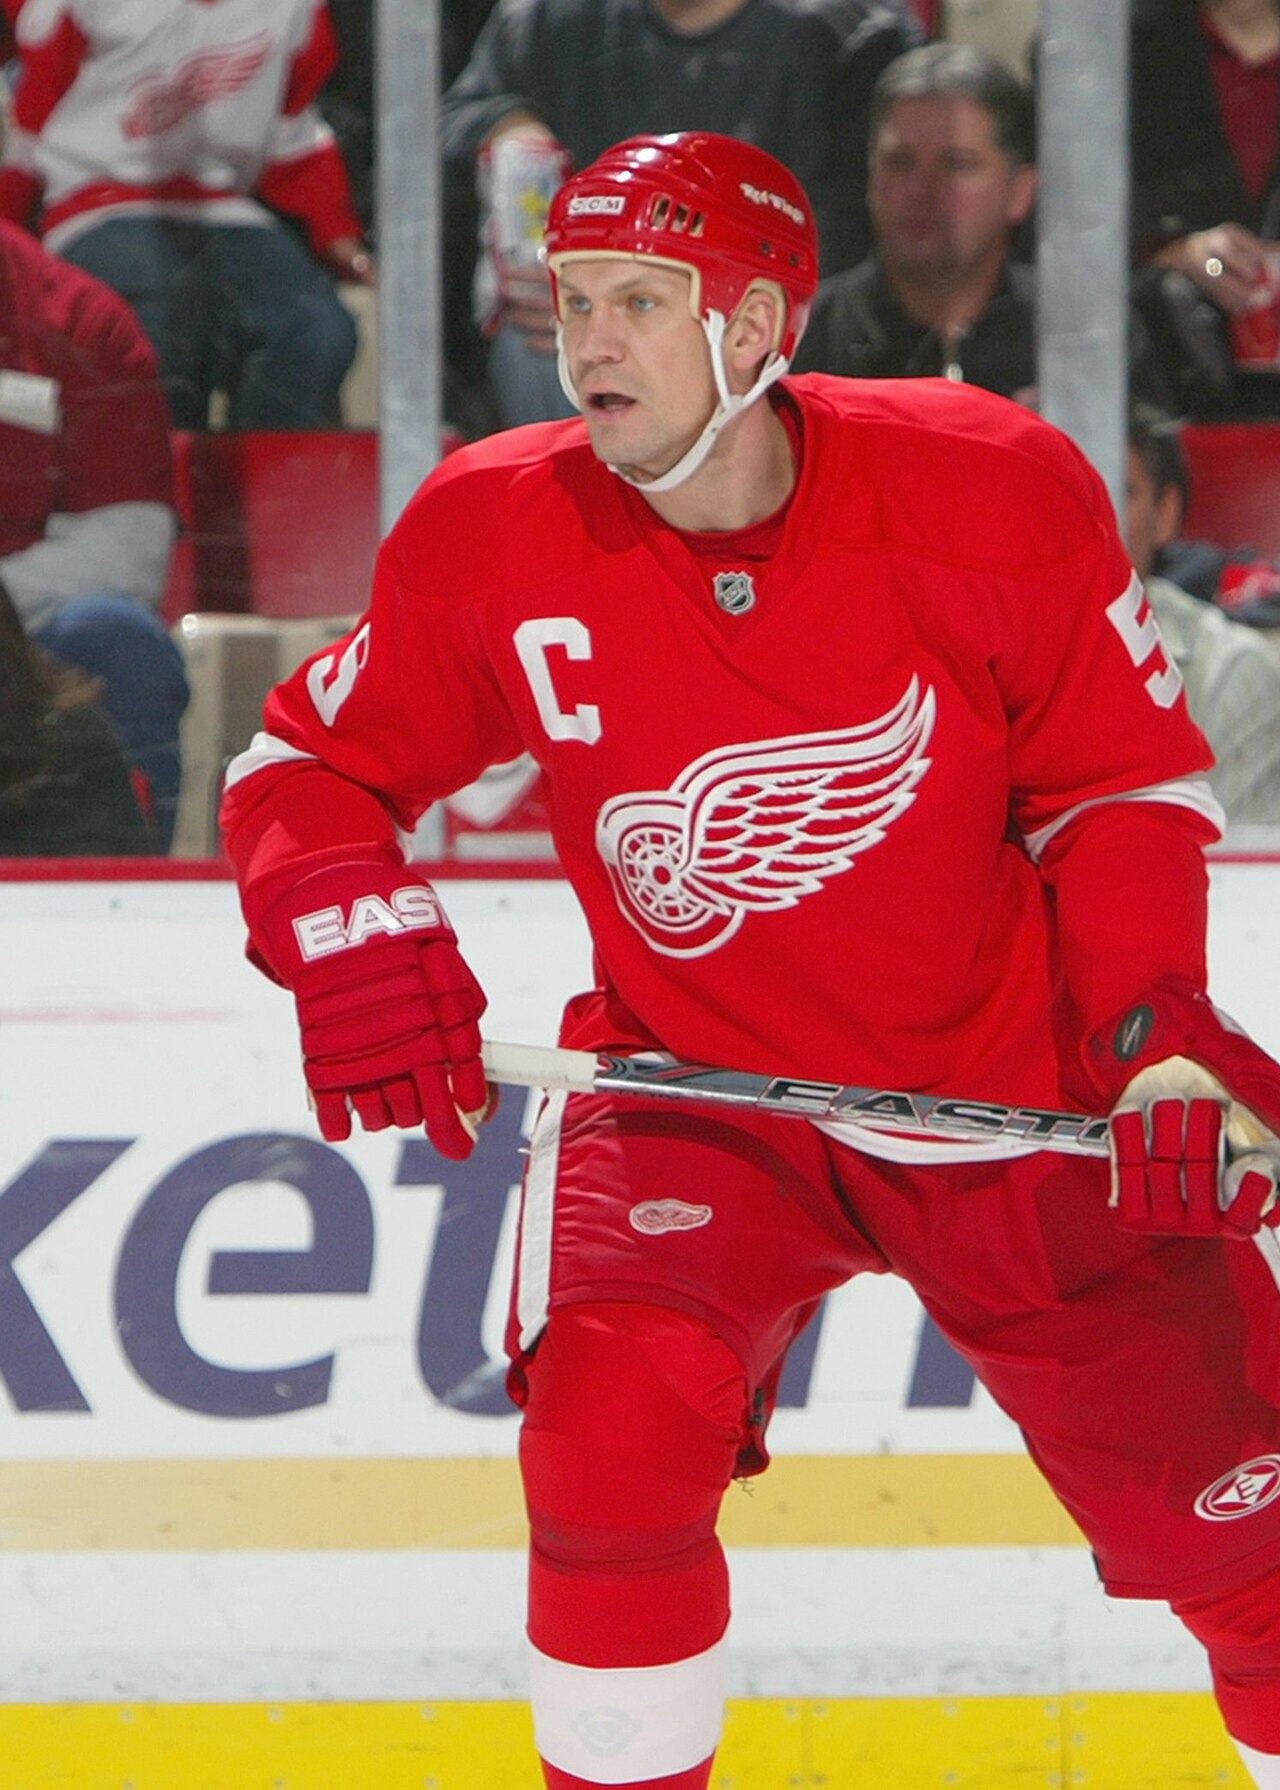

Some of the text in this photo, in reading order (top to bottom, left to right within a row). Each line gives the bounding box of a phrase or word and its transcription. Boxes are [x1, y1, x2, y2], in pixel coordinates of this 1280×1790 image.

[513, 617, 602, 745] C
[1105, 566, 1183, 709] 5
[292, 885, 453, 963] EAS
